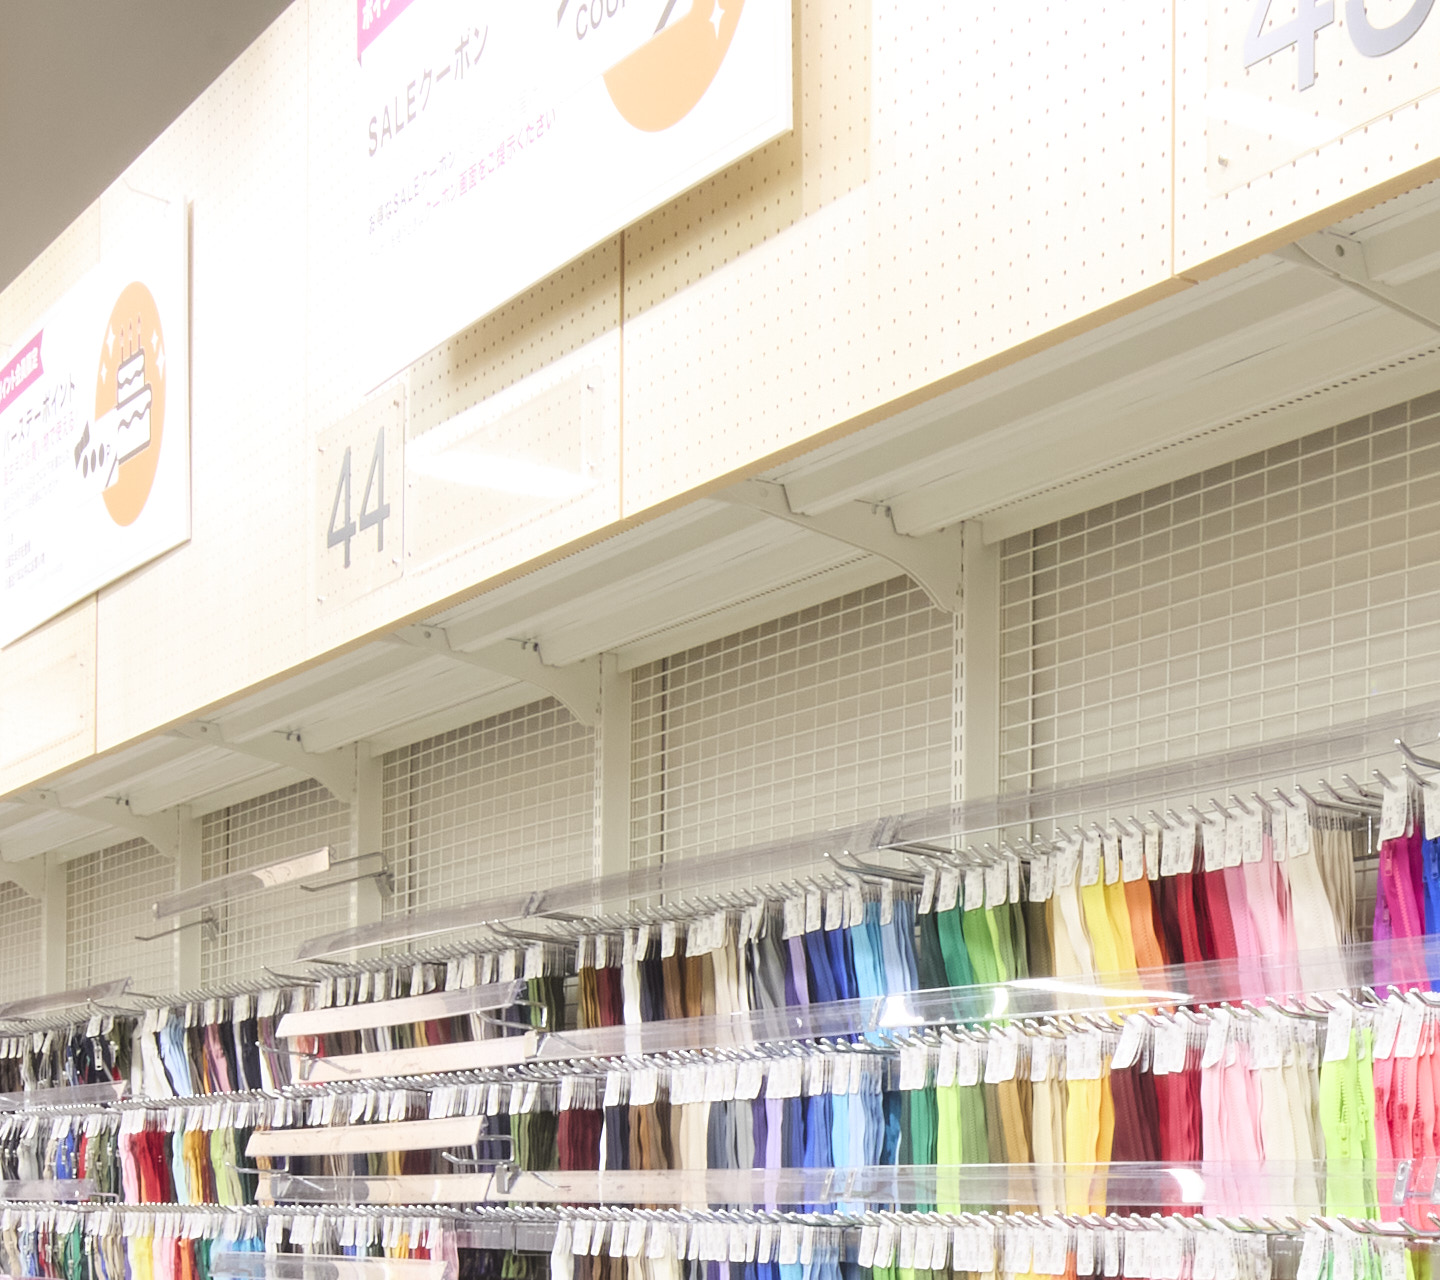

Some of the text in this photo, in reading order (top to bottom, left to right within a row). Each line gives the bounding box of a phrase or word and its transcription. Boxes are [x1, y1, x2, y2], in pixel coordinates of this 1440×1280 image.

[368, 24, 488, 157] SALEクーポン
[326, 426, 391, 568] 44
